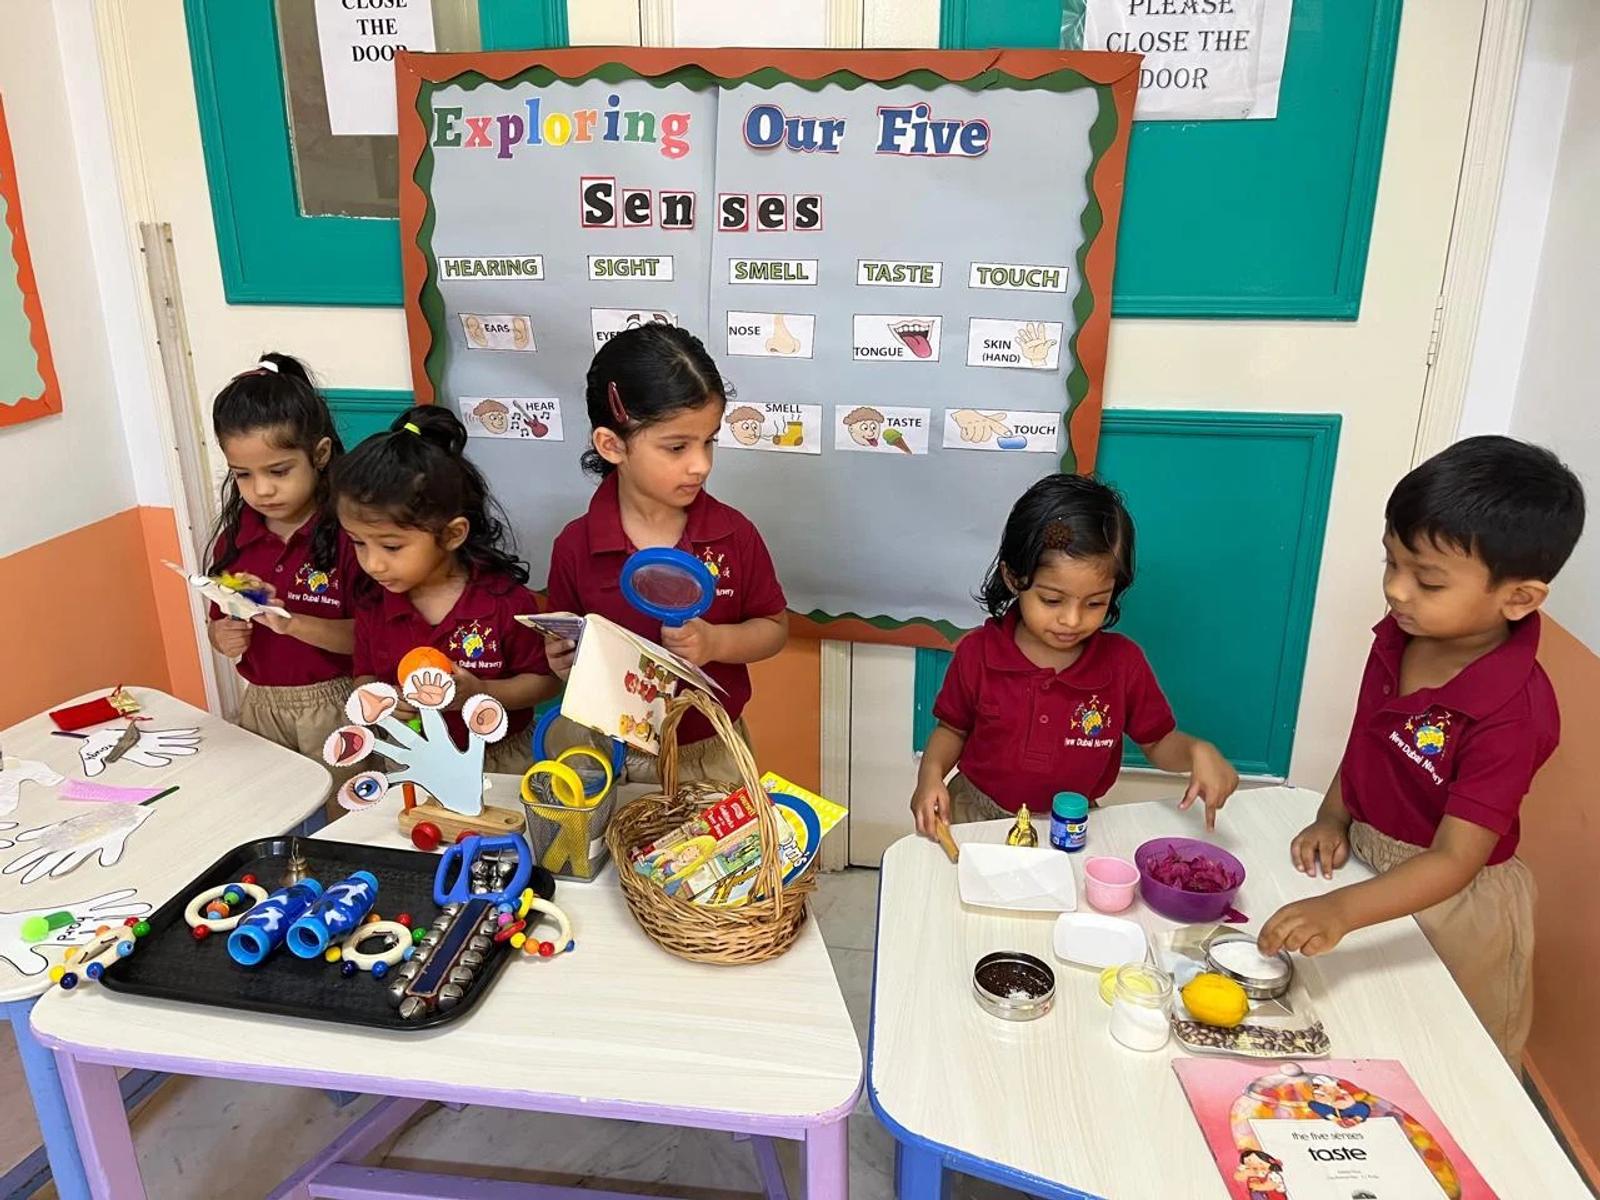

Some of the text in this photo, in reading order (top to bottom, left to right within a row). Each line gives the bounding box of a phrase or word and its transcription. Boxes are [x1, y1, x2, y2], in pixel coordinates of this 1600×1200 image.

[1129, 0, 1234, 15] PLEASE
[356, 18, 398, 36] THE
[1106, 30, 1250, 53] CLOSE THE
[1140, 67, 1208, 89] DOOR
[432, 94, 989, 159] Exploring Our Five
[444, 258, 538, 278] HEARING
[594, 258, 659, 277] SIGHT
[734, 261, 809, 281] SMELL
[863, 263, 935, 284] TASTE
[976, 266, 1060, 289] TOUCH
[484, 323, 510, 334] EARS
[728, 325, 761, 337] NOSE
[854, 346, 904, 358] TONGUE
[983, 339, 1012, 351] SKIN
[982, 352, 1021, 364] (HAND)
[525, 401, 555, 411] HEAR
[765, 403, 803, 415] SMELL
[886, 417, 922, 429] TASTE
[1013, 424, 1056, 437] TOUCH
[1291, 1131, 1364, 1141] the five senses
[1308, 1146, 1367, 1161] taste
